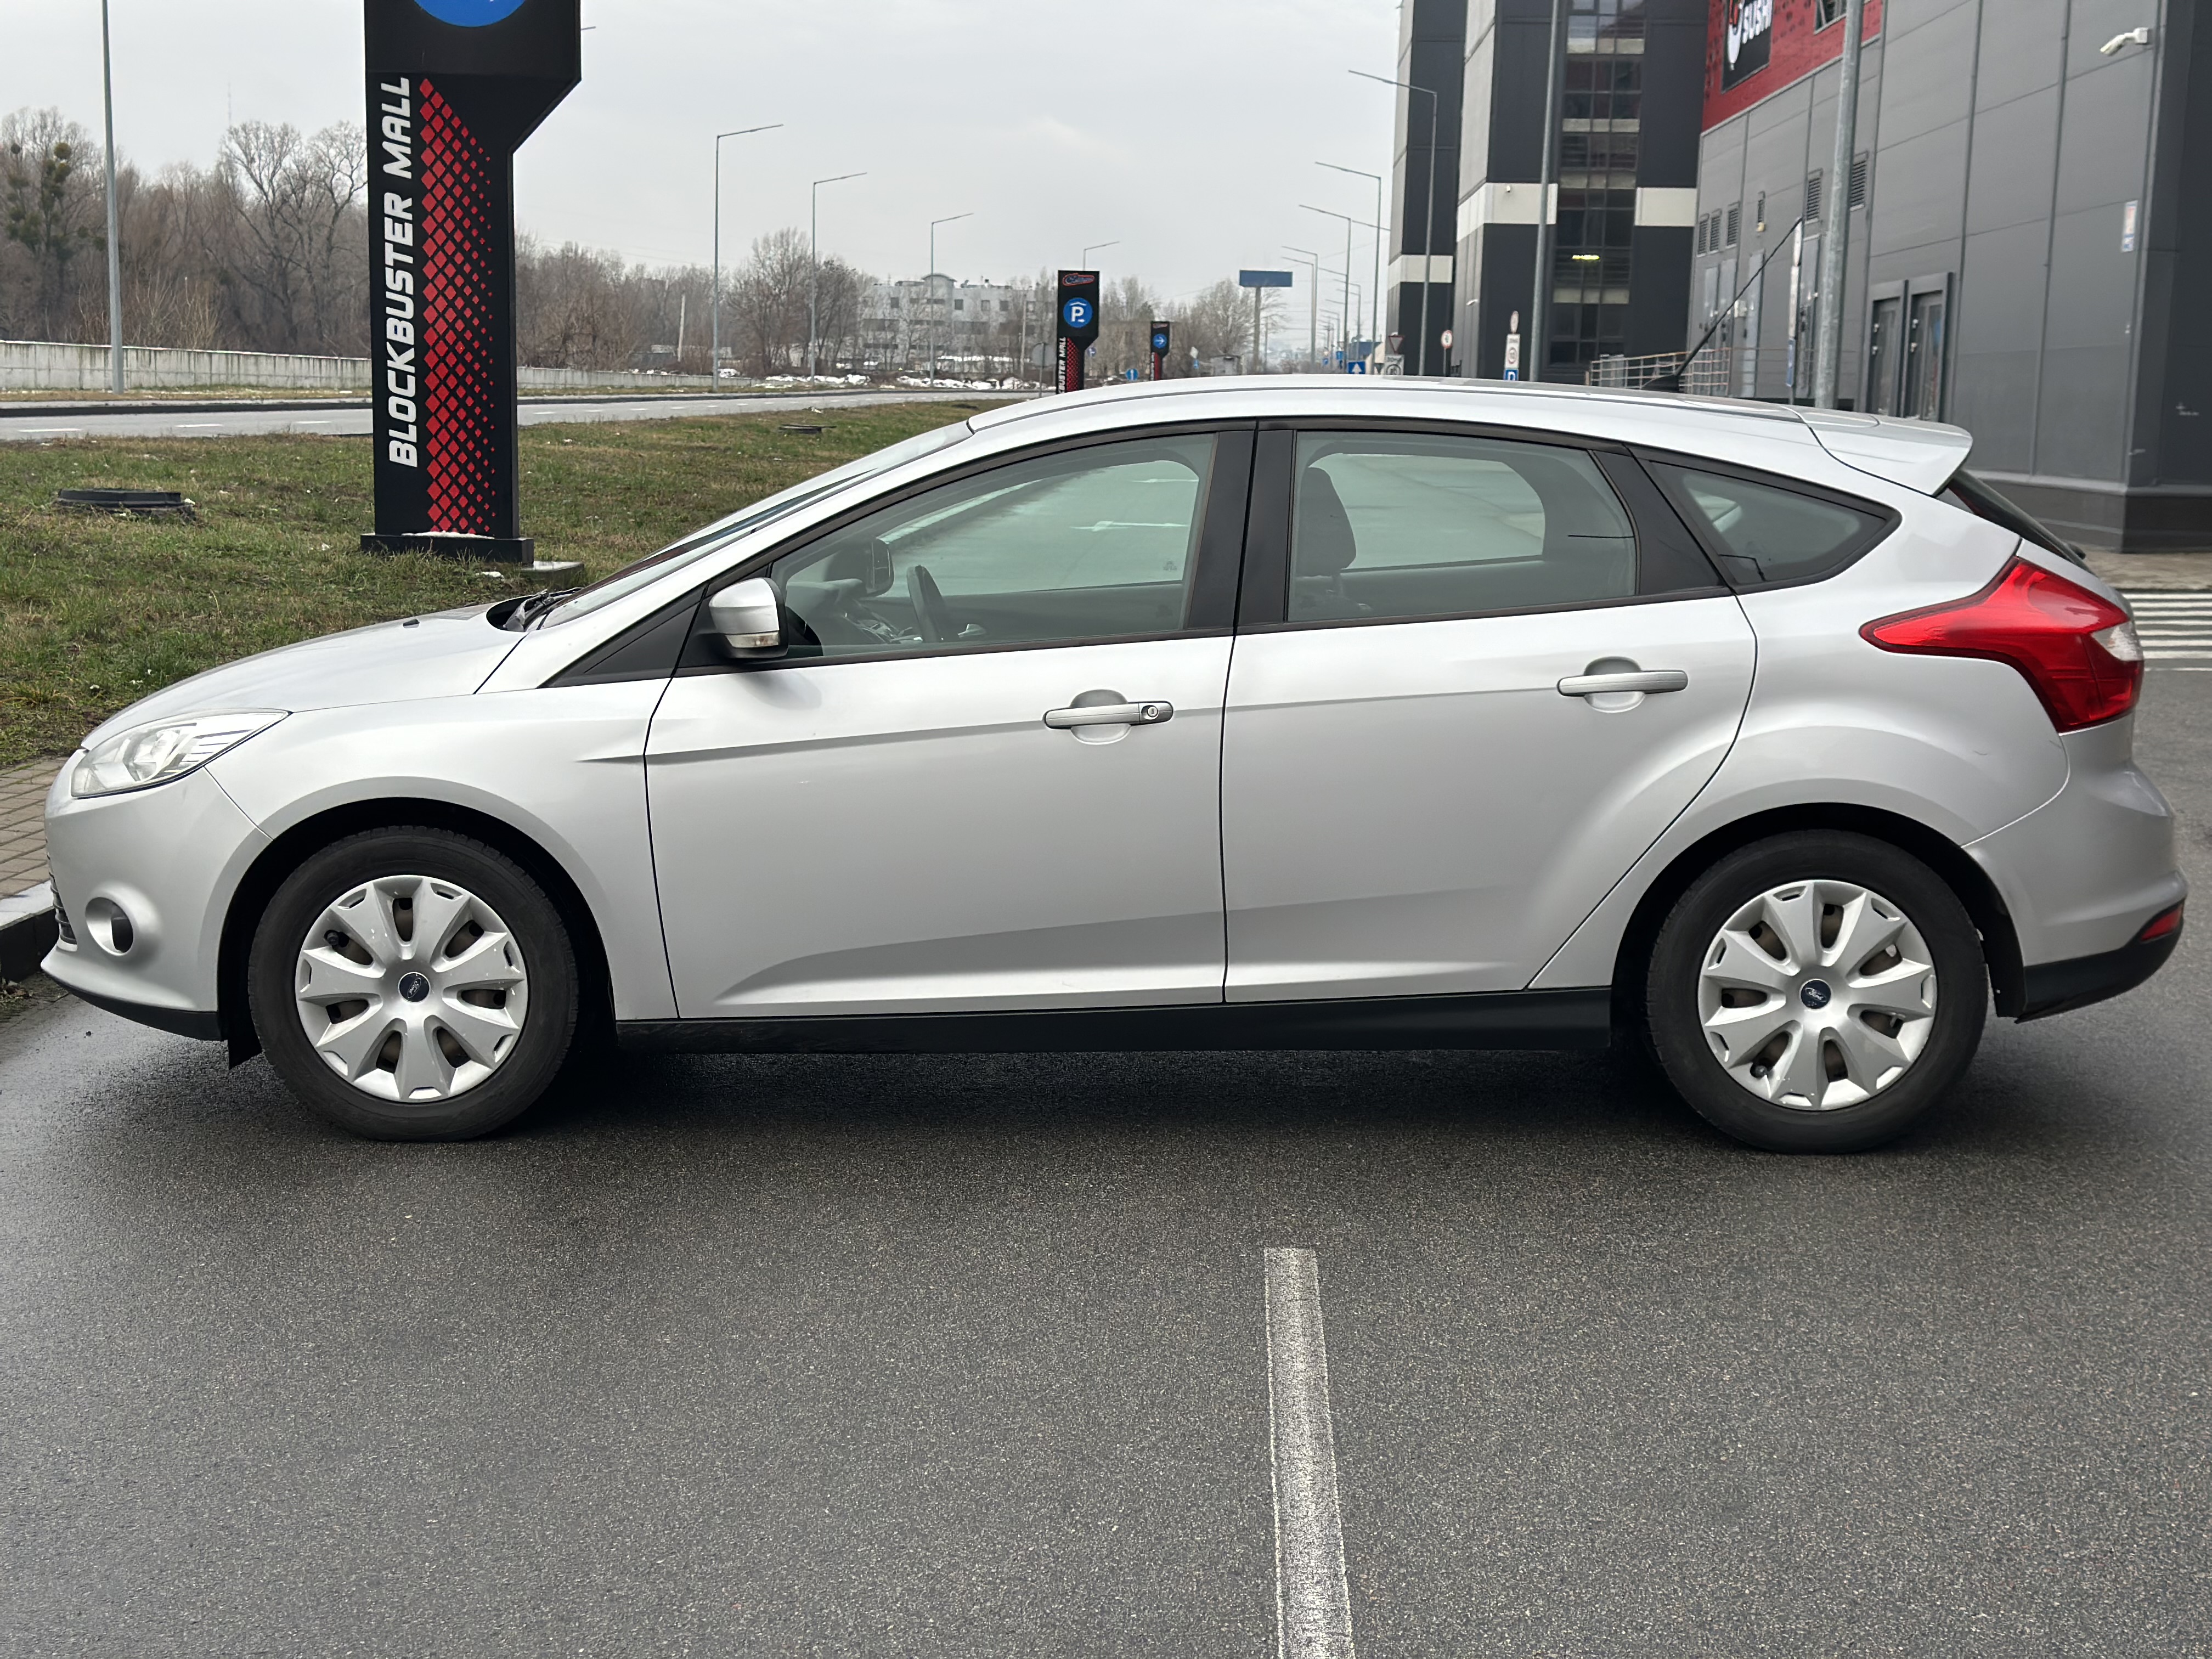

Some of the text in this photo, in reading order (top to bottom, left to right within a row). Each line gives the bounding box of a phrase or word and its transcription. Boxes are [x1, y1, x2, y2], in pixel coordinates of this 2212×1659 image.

[381, 77, 417, 468] BLOCKBUSTER MALL
[1071, 306, 1084, 322] P
